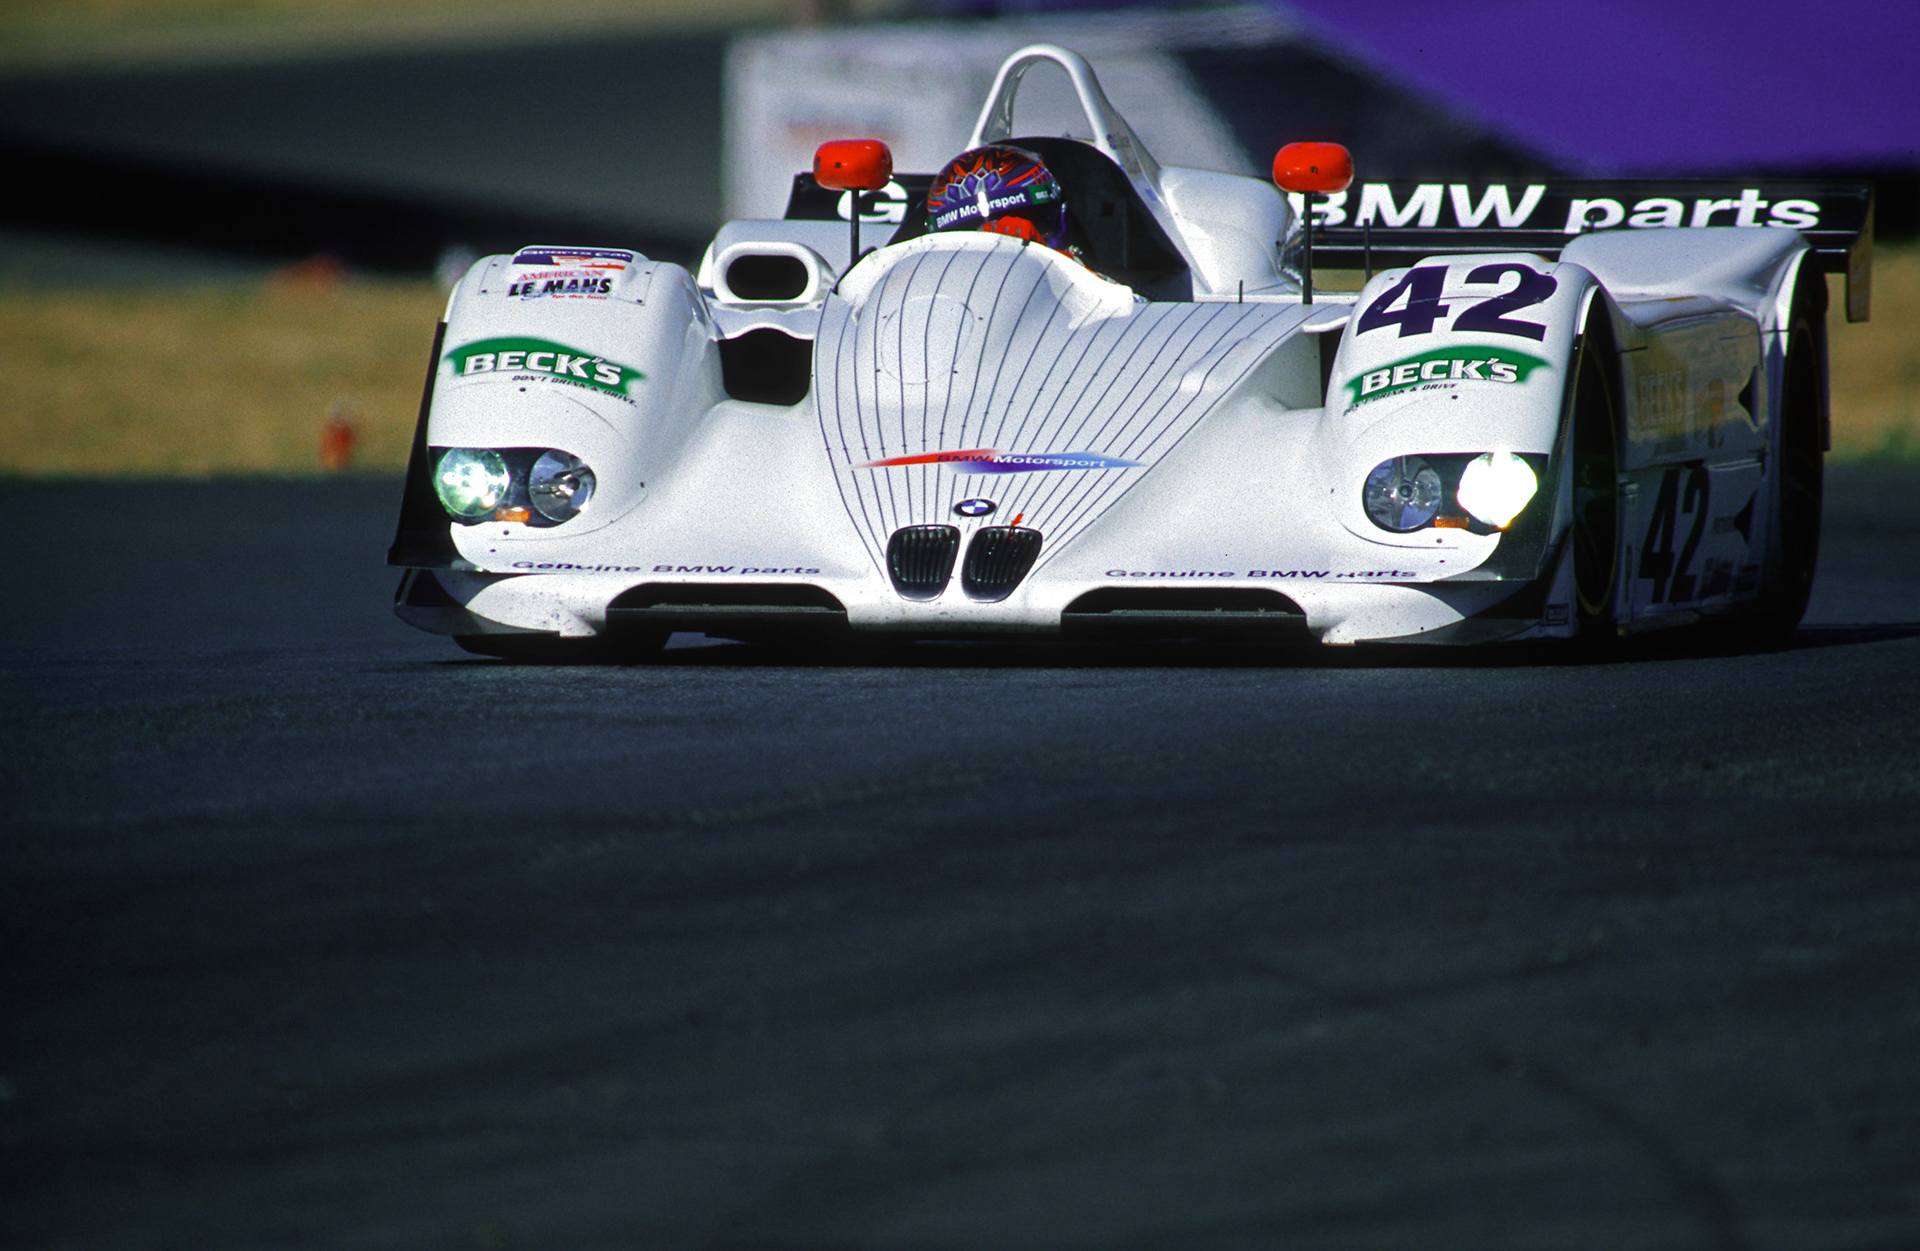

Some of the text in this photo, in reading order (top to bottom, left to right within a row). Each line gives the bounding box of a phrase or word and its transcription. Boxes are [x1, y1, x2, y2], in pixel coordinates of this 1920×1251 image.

[936, 192, 1026, 228] BMW Motrsport
[1287, 183, 1546, 228] BMW
[1564, 188, 1821, 234] parts
[508, 281, 535, 297] LE
[542, 278, 611, 293] MANS
[518, 269, 606, 281] AMERICAN
[1356, 263, 1558, 342] 42
[461, 351, 622, 386] BECK'S
[1360, 357, 1518, 396] BECK'S
[551, 377, 586, 389] DRINK
[938, 454, 1107, 467] BMW Motorsport
[1638, 461, 1711, 604] 42
[512, 560, 822, 575] Genuine BMW parts
[1105, 569, 1236, 578] Genuine
[1247, 569, 1331, 578] BMW
